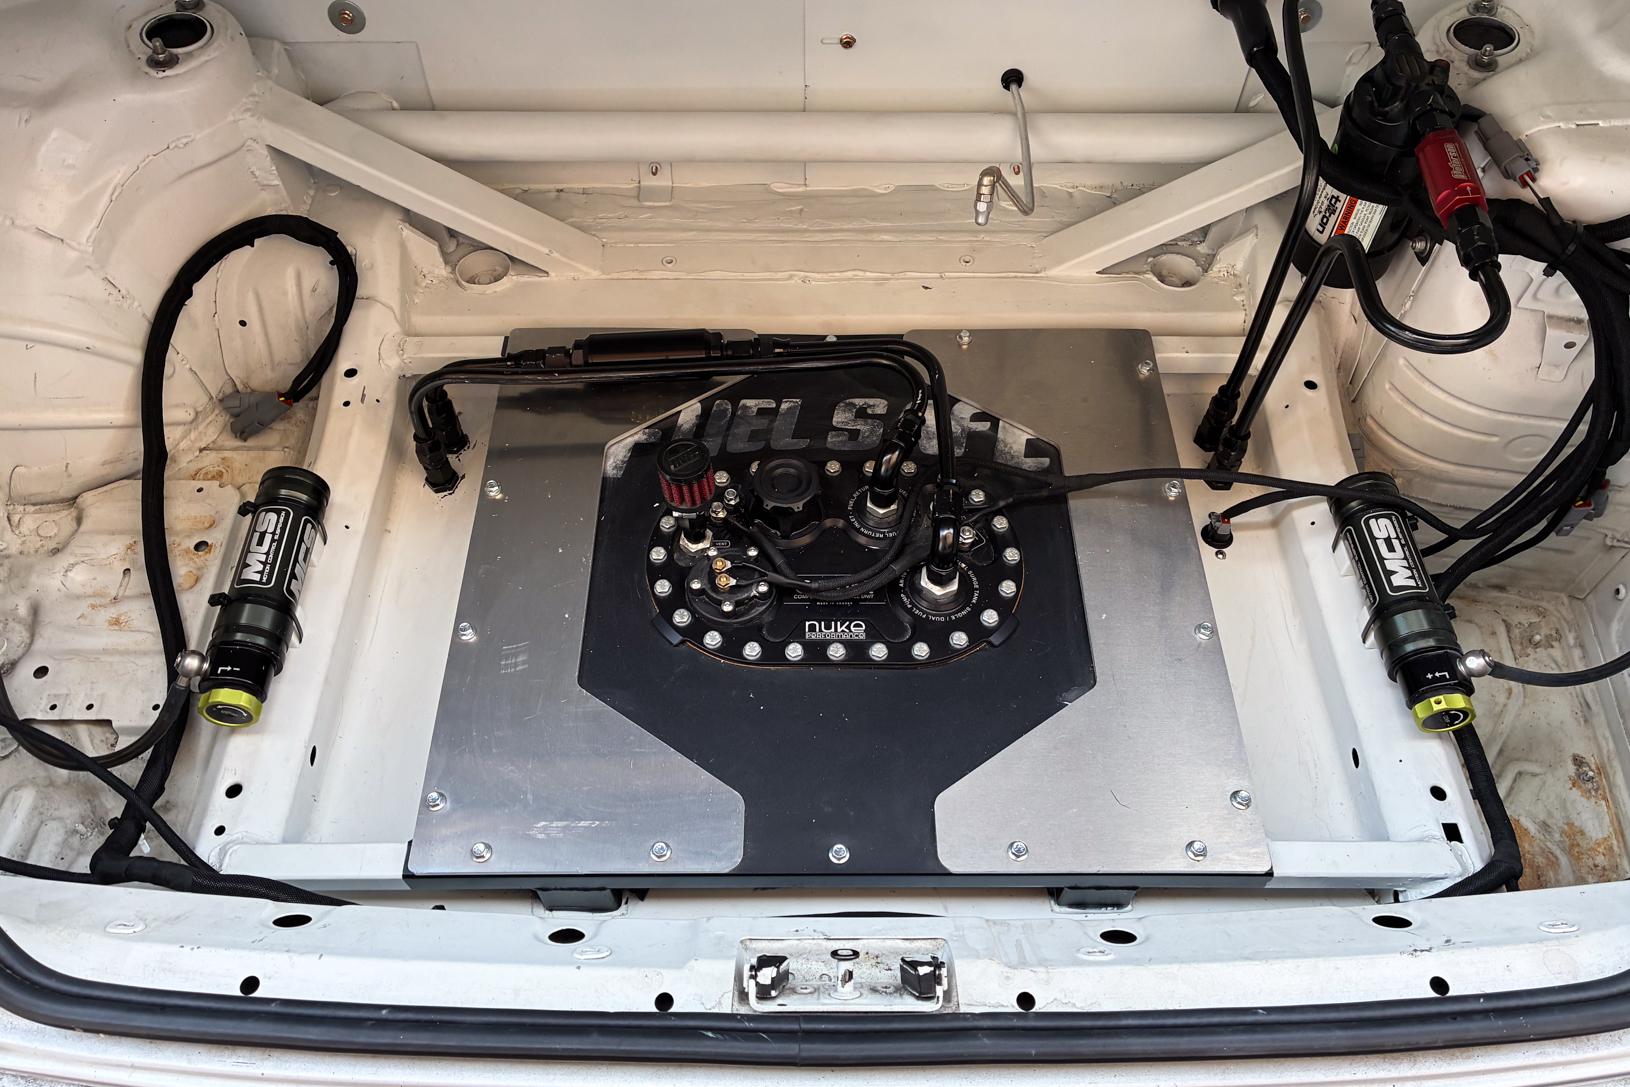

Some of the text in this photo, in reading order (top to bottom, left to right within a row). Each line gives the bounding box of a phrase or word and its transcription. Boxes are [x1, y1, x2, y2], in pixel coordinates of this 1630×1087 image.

[1338, 197, 1357, 231] WARNING
[240, 511, 278, 582] MCS
[261, 511, 286, 583] MOTION CONTROL SUSPENSION
[1369, 518, 1417, 586] MCS
[900, 593, 913, 608] PUMP
[971, 590, 980, 604] TANK
[912, 608, 927, 618] FUEL
[951, 607, 972, 620] SINGLE
[805, 620, 866, 633] nuke
[805, 632, 866, 640] PERFORMANCE
